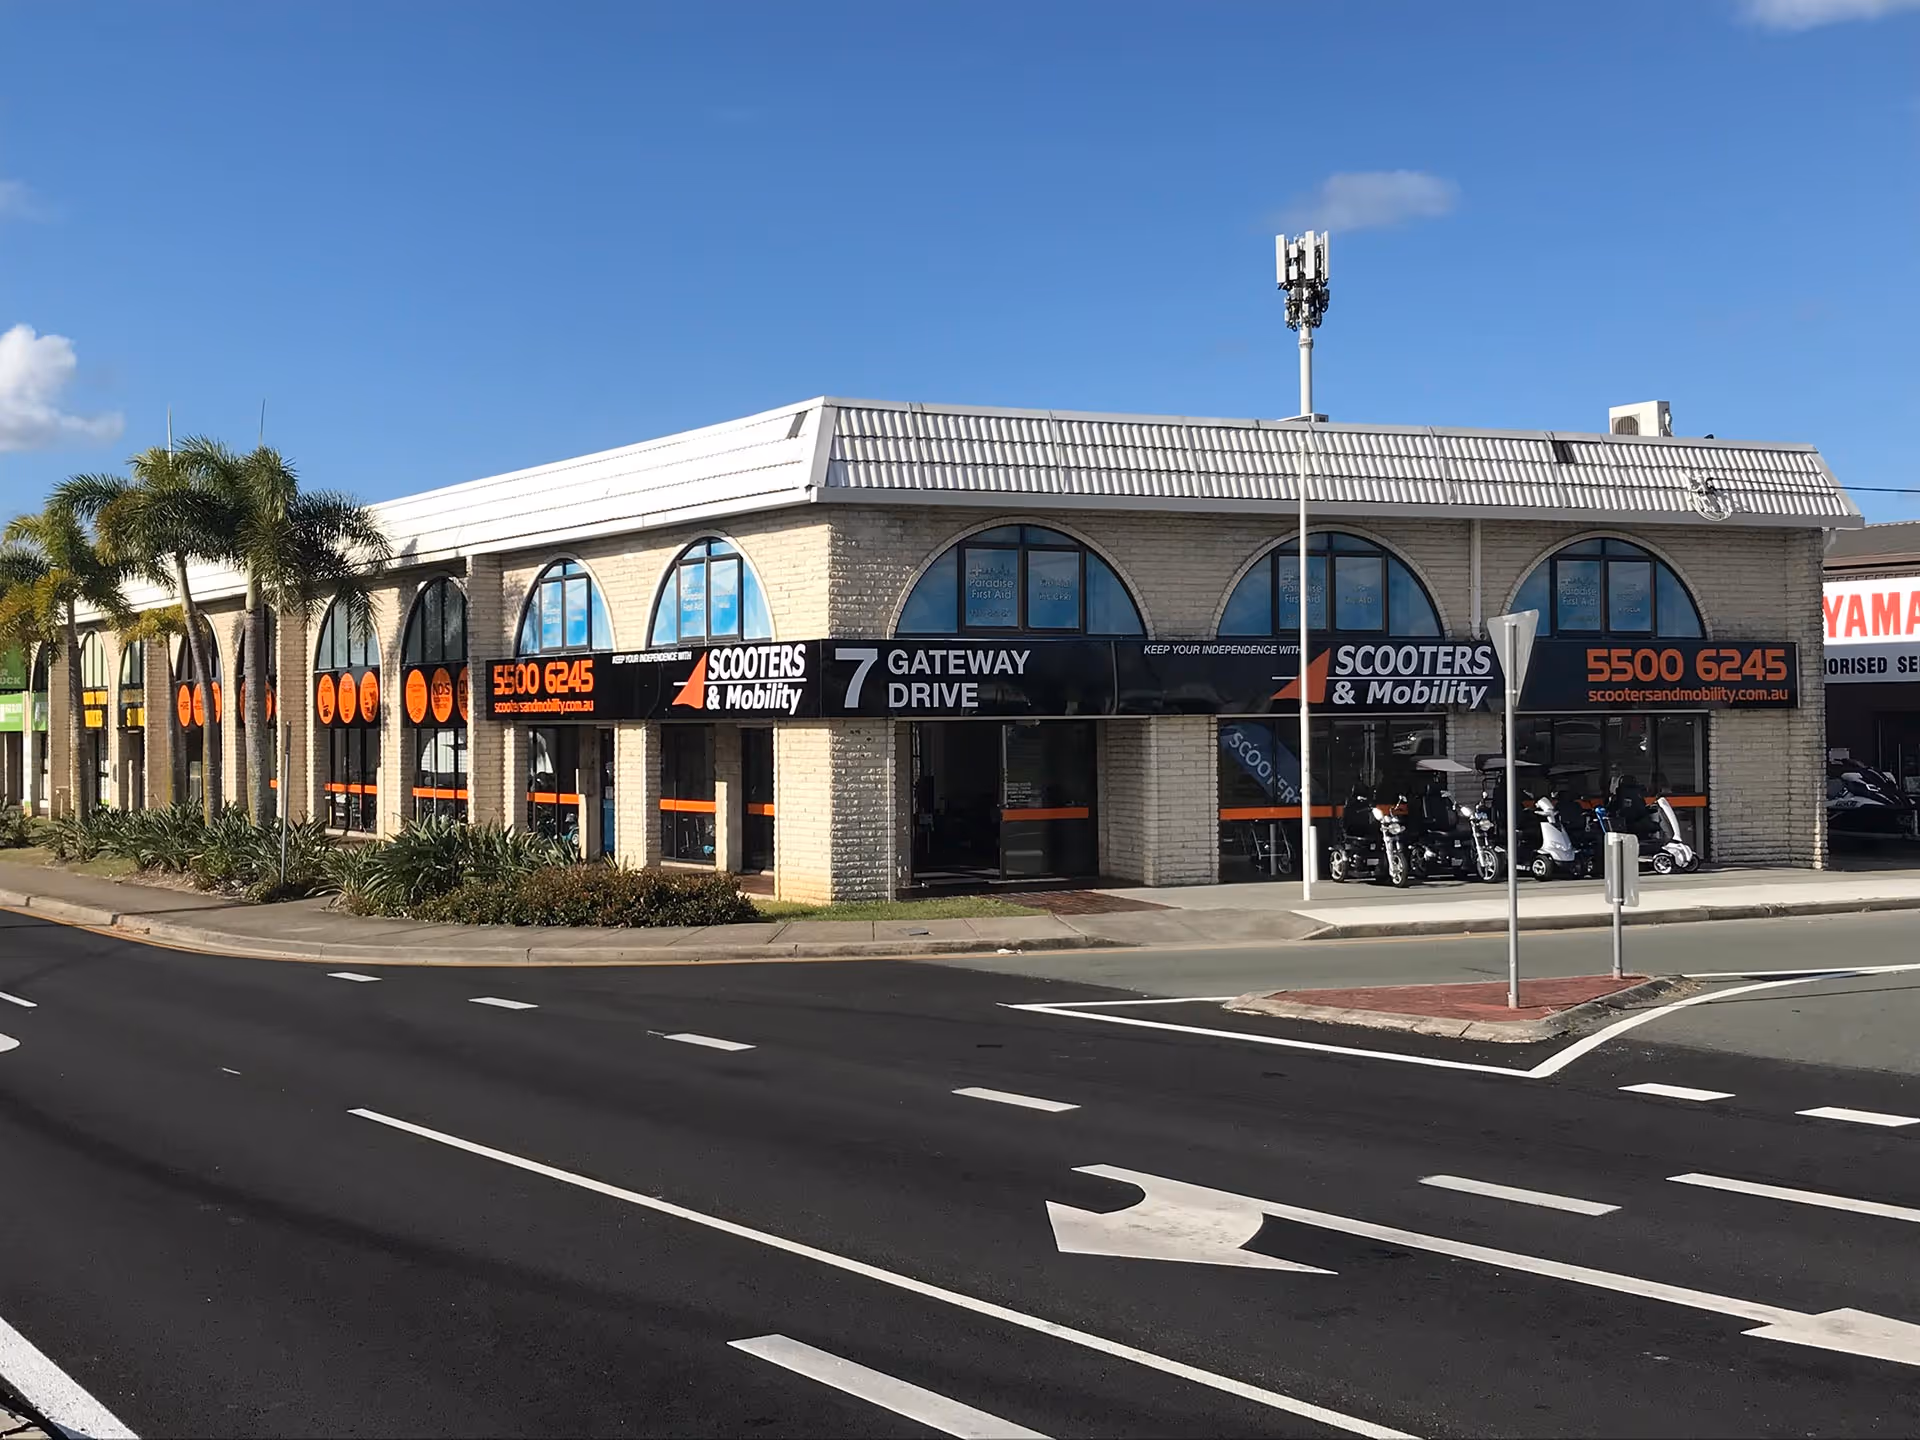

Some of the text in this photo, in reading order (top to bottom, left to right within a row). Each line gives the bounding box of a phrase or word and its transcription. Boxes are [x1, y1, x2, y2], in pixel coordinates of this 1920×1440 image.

[969, 578, 1014, 589] Paradise
[971, 590, 1012, 600] First Aid
[708, 643, 807, 681] SCOOTERS
[1144, 645, 1171, 655] KEEP
[1172, 645, 1200, 655] YOUR
[1201, 645, 1278, 656] INDEPENDENCE
[1335, 645, 1492, 675] SCOOTERS
[1586, 648, 1788, 682] 5500 6245
[1824, 656, 1920, 675] ORISED SE
[493, 659, 594, 696] 5500 6245
[835, 648, 1031, 709] 7 GATEWAY
[706, 681, 803, 716] & Mobility
[888, 683, 979, 708] DRIVE
[1332, 680, 1488, 710] & Mobility
[1588, 687, 1789, 705] scootersandmobility.com.au
